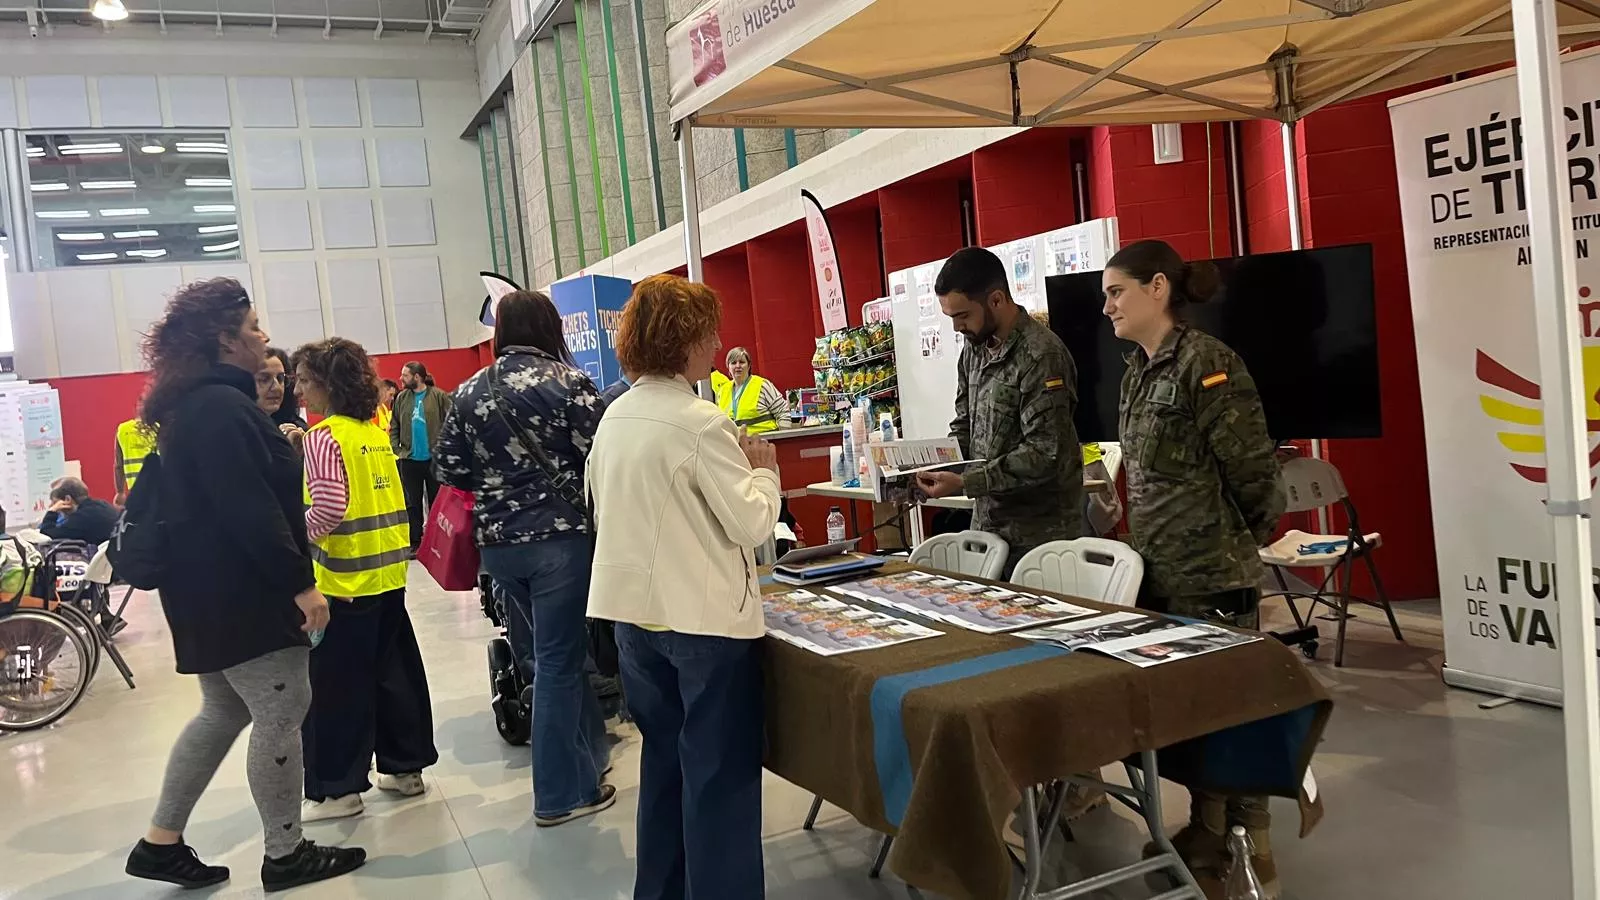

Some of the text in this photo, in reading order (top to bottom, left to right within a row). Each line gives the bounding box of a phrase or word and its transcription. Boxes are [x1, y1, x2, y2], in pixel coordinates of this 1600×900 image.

[726, 22, 741, 47] de
[1431, 188, 1473, 224] DE
[1464, 575, 1488, 592] LA
[1467, 599, 1489, 617] DE
[1469, 621, 1500, 640] LOS
